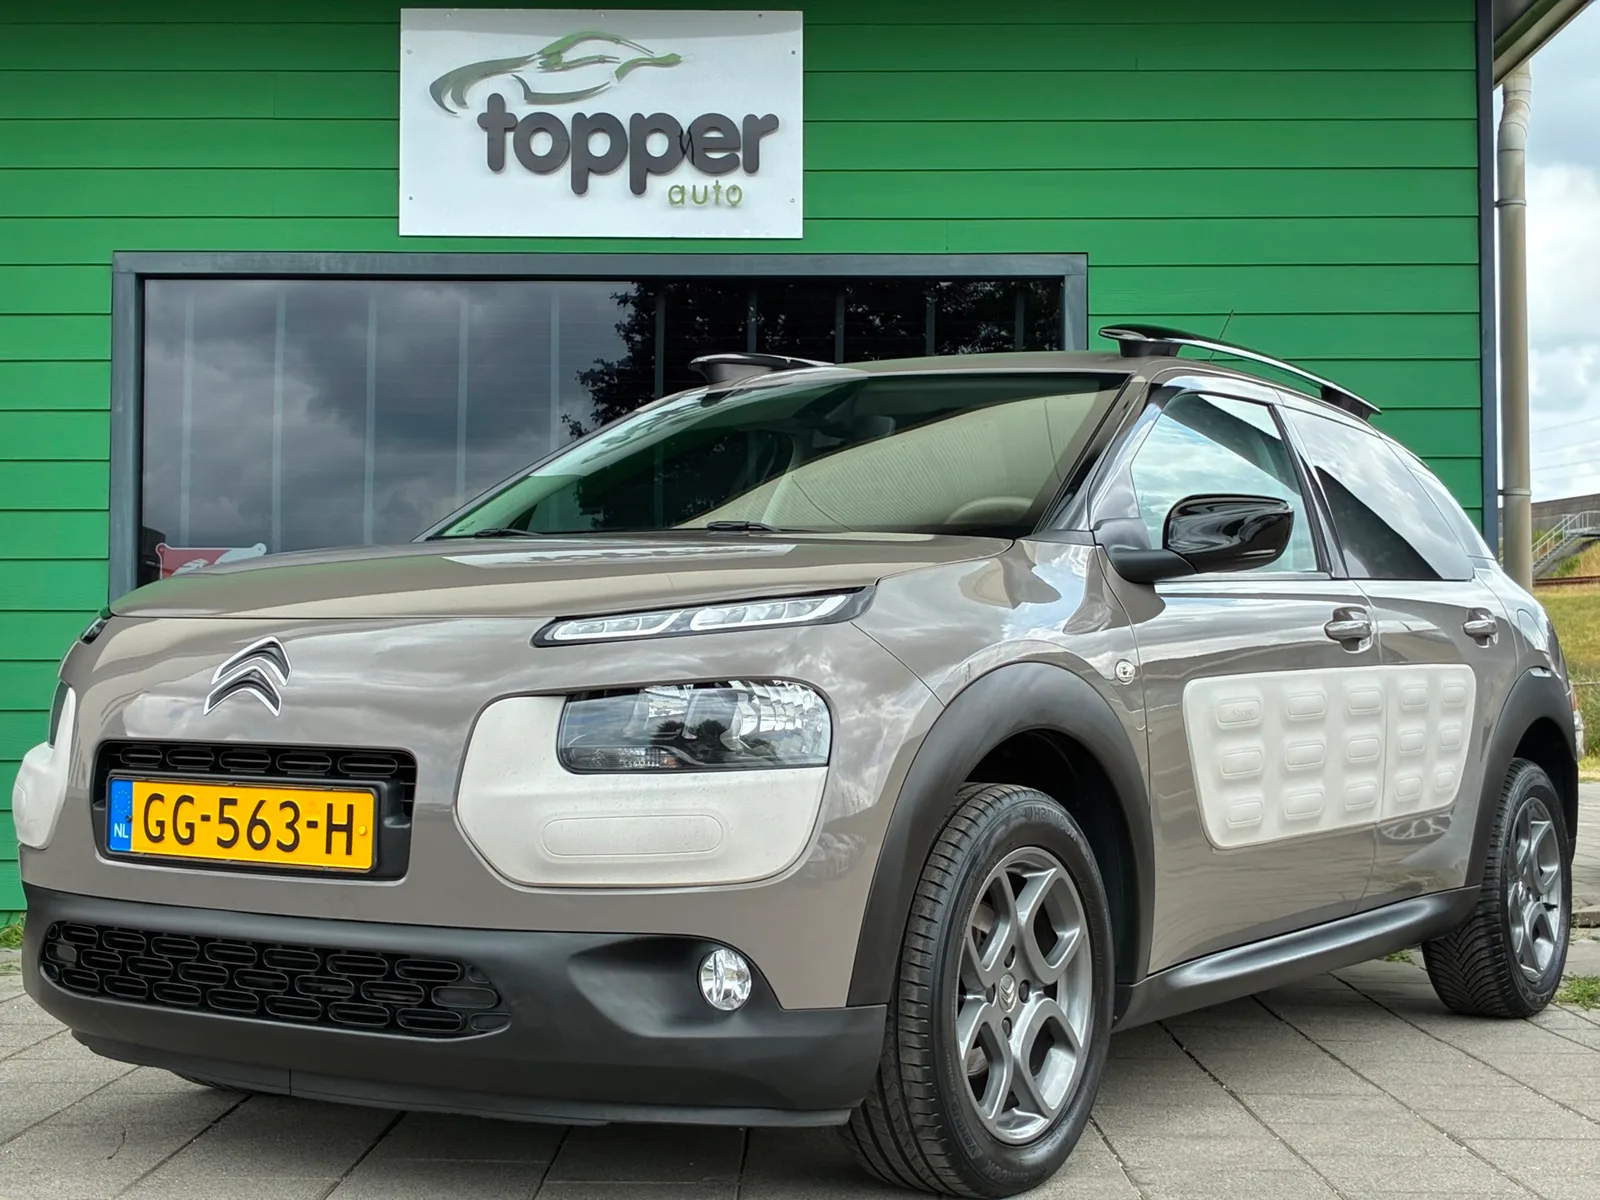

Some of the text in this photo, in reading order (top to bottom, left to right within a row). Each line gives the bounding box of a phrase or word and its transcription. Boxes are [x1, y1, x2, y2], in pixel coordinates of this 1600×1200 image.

[477, 93, 779, 195] topper
[668, 179, 743, 206] auto
[114, 823, 129, 838] NL
[143, 793, 354, 855] GG-563-H
